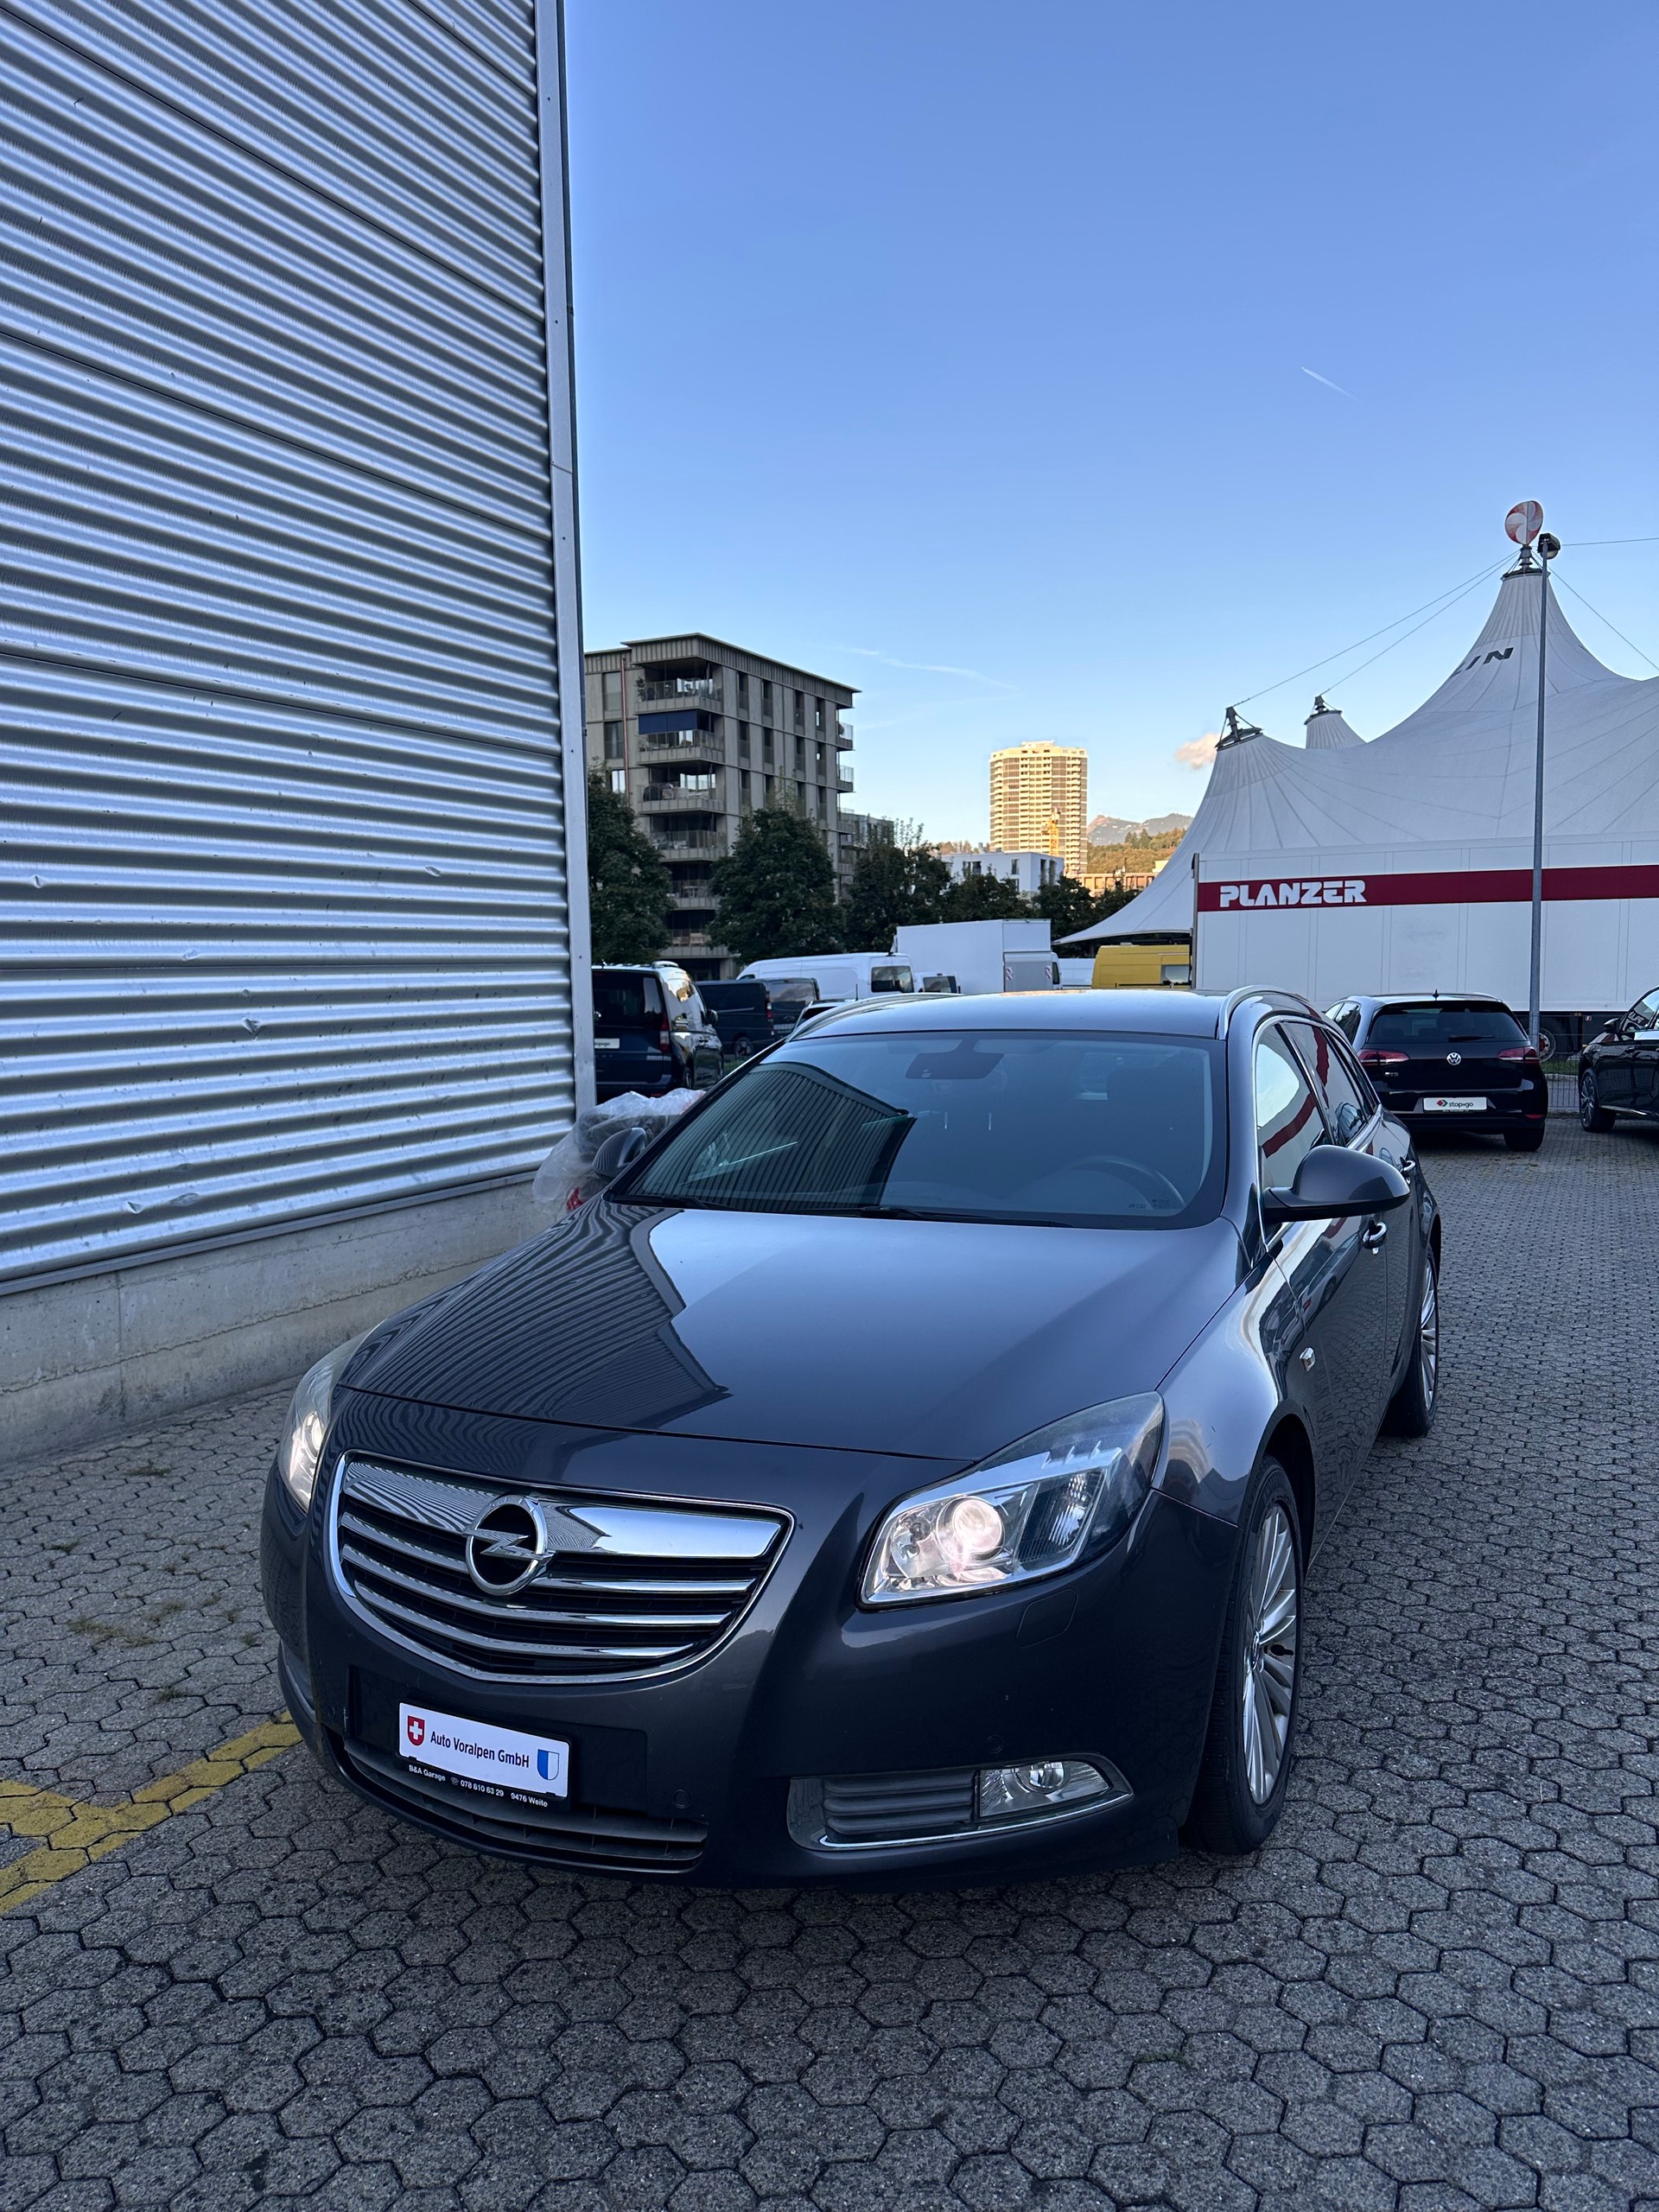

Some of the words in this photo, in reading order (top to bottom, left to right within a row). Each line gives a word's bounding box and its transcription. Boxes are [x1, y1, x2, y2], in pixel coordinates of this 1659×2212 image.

[1219, 880, 1367, 908] PLANZER
[430, 1731, 451, 1749] Auto
[453, 1737, 495, 1760] Voralpen
[498, 1749, 530, 1768] GmbH
[409, 1764, 423, 1775] B&A
[423, 1769, 446, 1782] Garage
[461, 1779, 473, 1789] 078
[495, 1789, 505, 1797] 29
[511, 1792, 528, 1802] 9476
[528, 1796, 549, 1808] Weite
